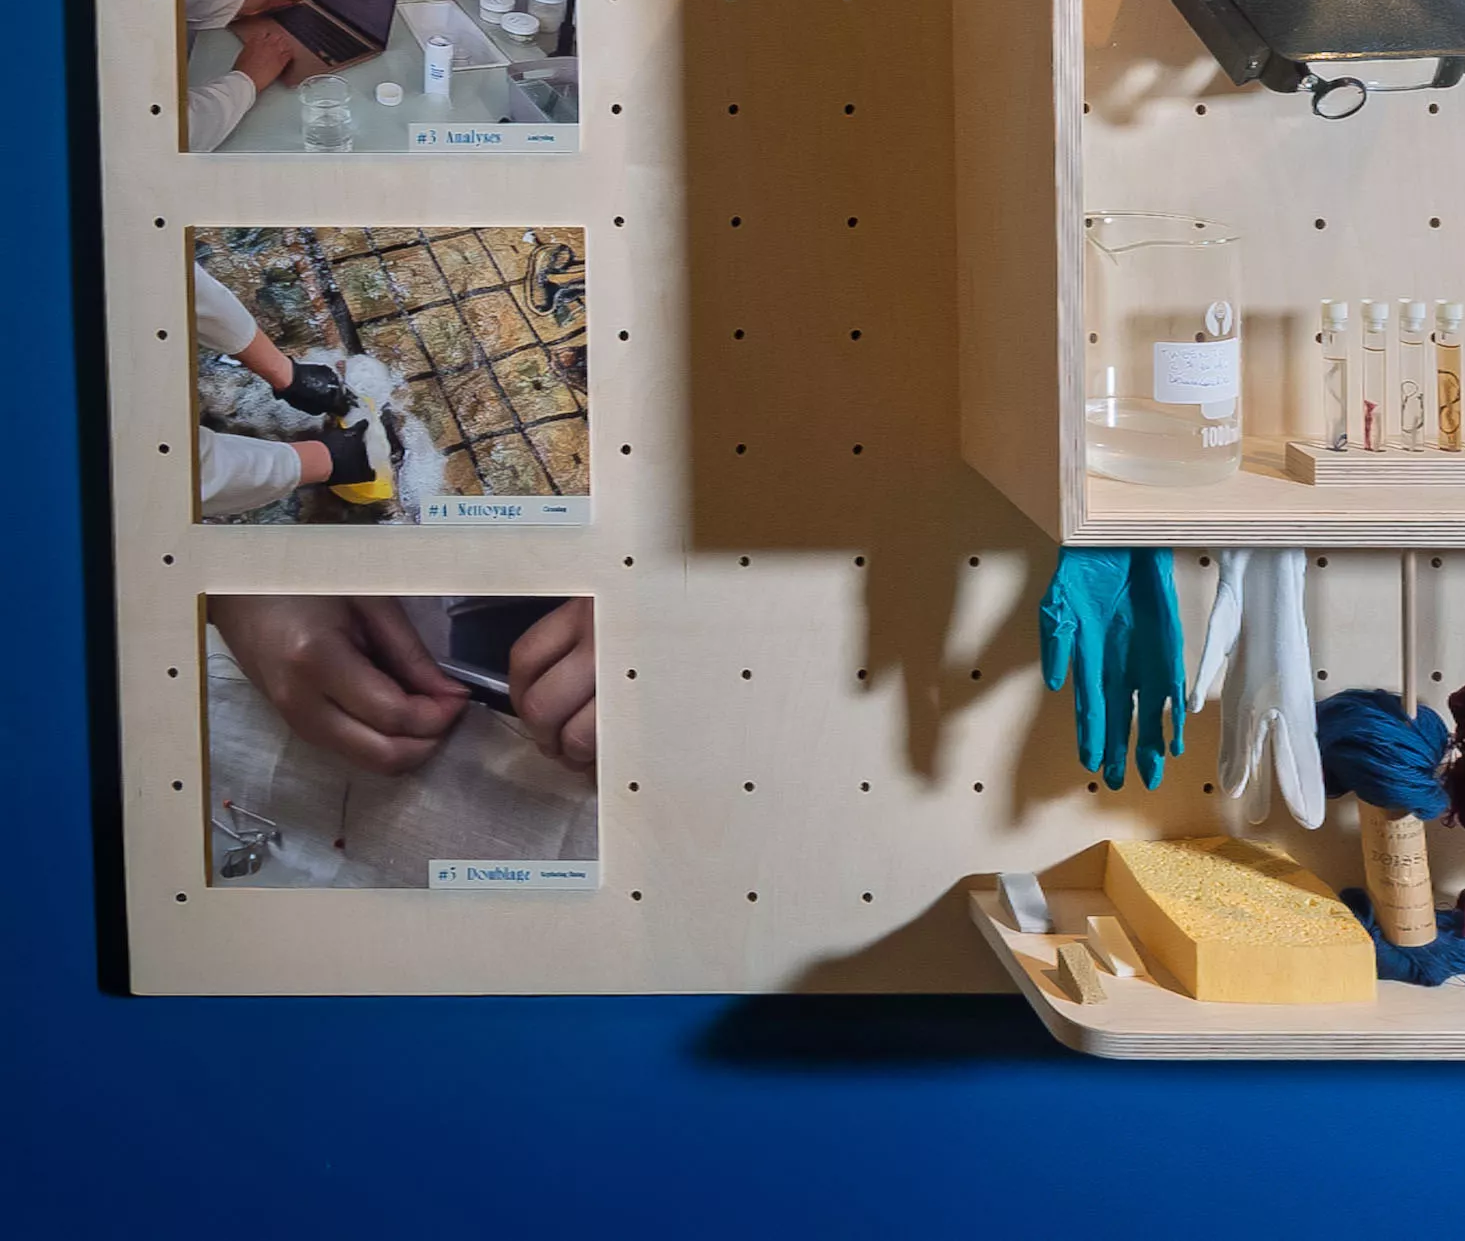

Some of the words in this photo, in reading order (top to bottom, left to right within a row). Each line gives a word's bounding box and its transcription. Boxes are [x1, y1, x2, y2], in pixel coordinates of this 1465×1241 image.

[417, 129, 437, 145] #3
[446, 129, 502, 147] Analyses
[457, 503, 523, 519] Nettoyage
[466, 867, 531, 883] Doublage
